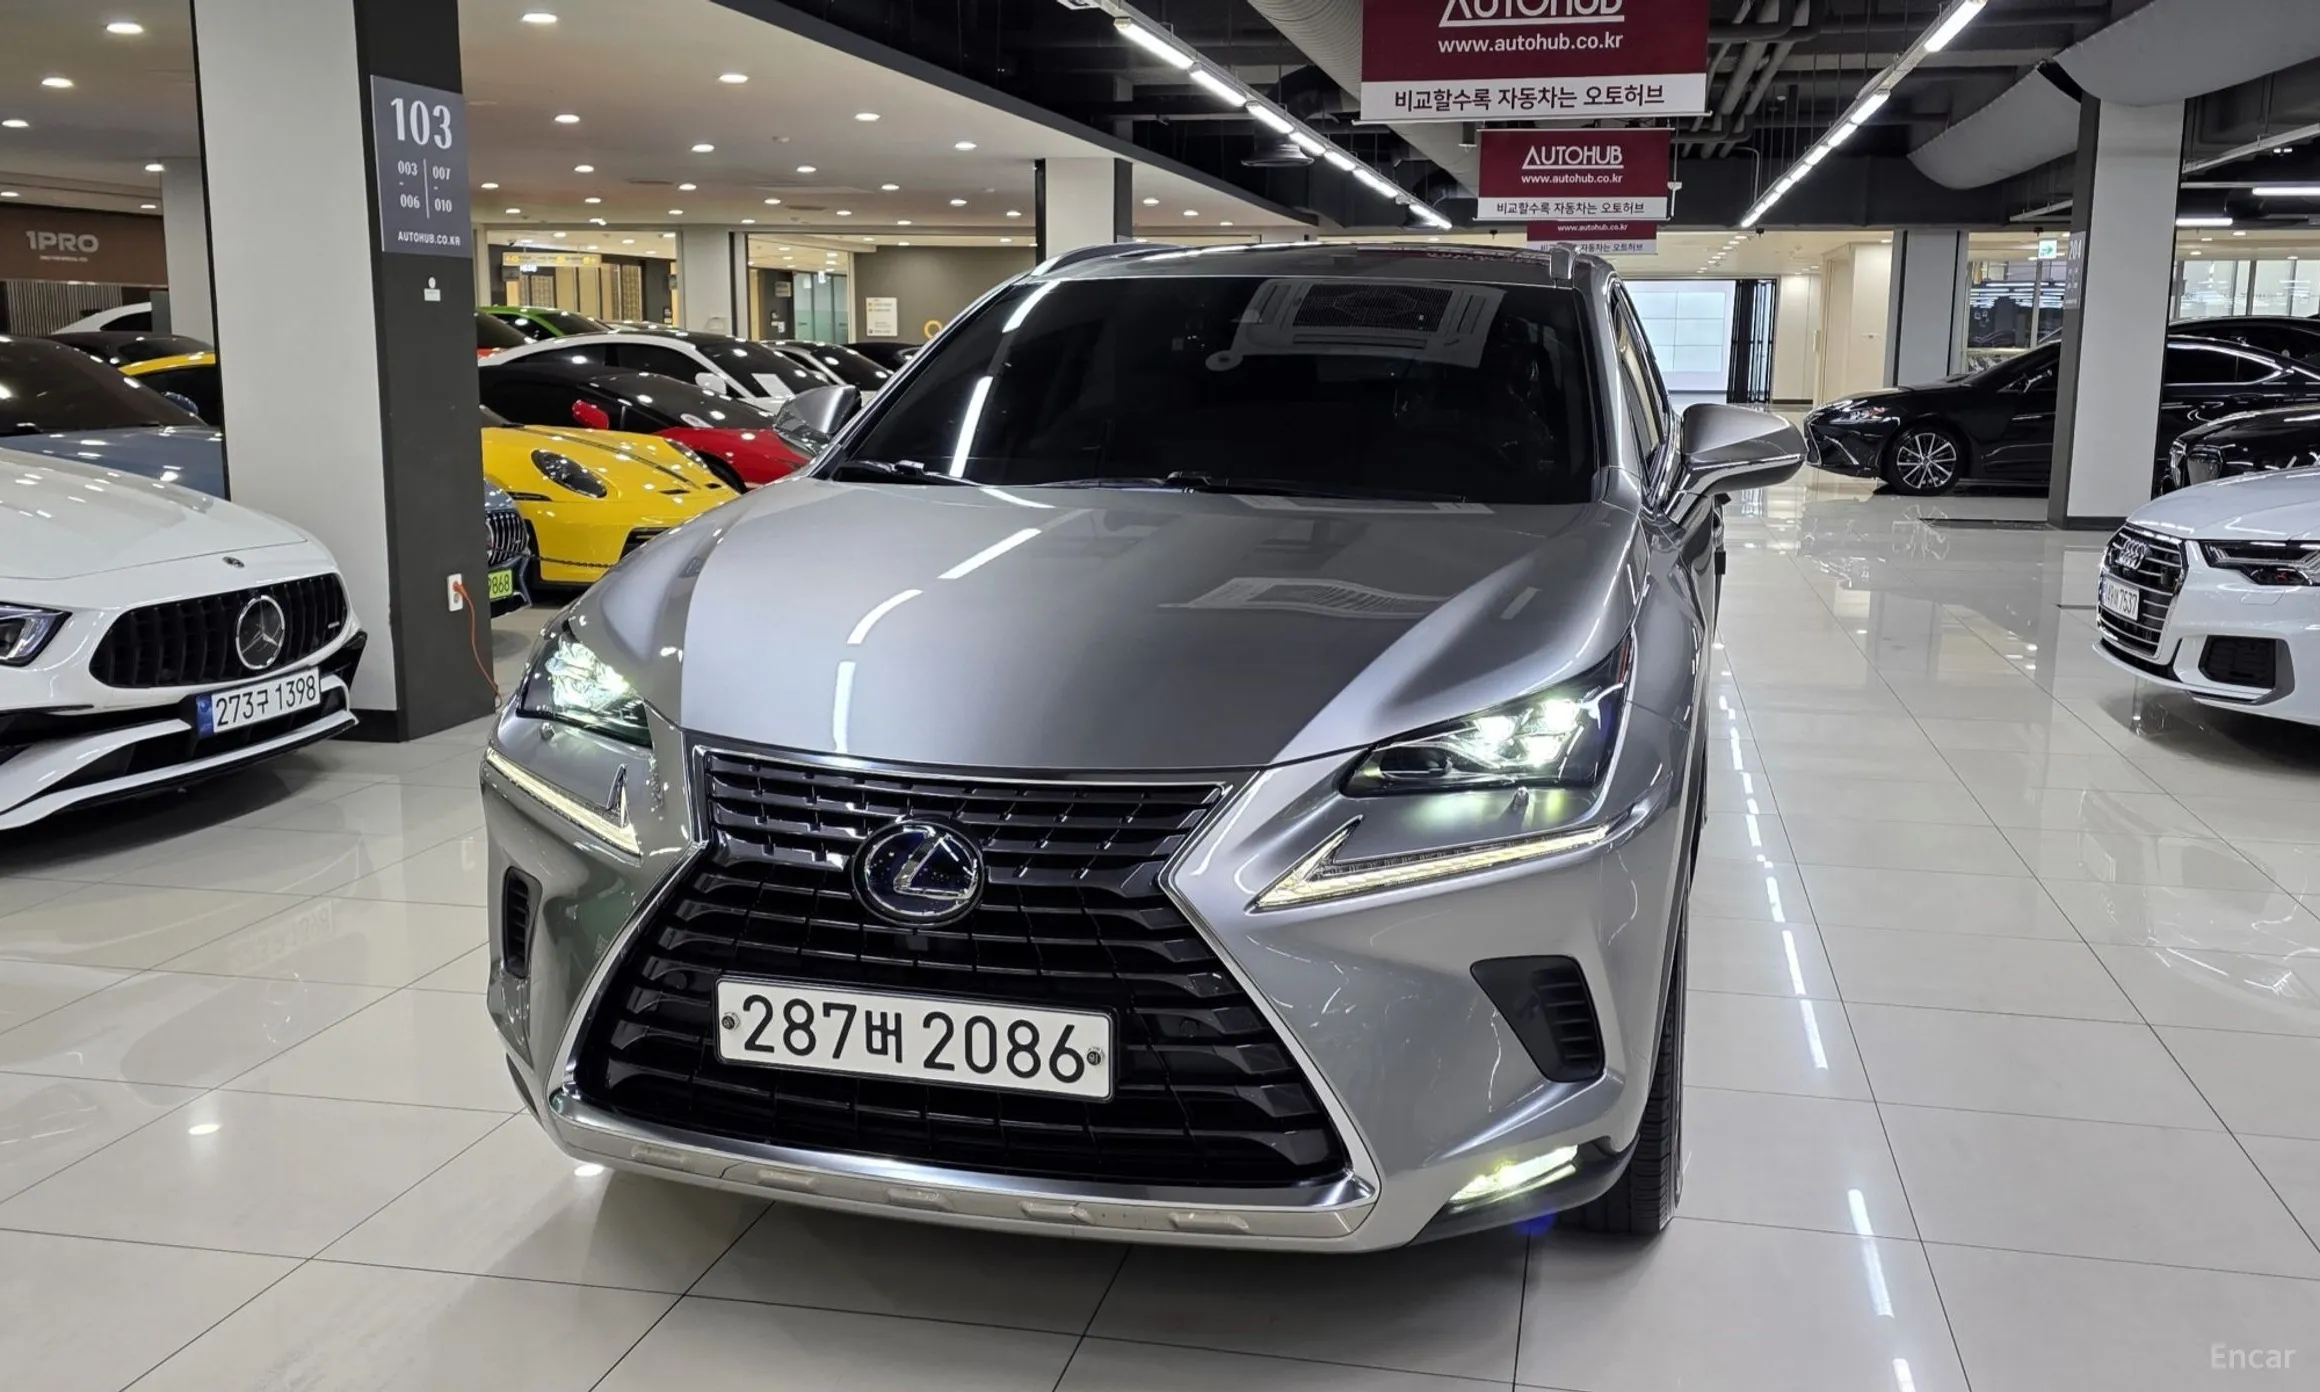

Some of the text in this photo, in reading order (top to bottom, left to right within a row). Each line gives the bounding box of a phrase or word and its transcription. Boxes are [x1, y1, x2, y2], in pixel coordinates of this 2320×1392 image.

[1438, 31, 1624, 53] www.autohub.co.kr
[1394, 83, 1665, 113] 비교할수록 자동차는 오토허브
[390, 97, 453, 150] 103
[1521, 145, 1624, 170] AUTOHUB
[397, 160, 418, 176] 003
[432, 166, 451, 181] 007
[1521, 173, 1624, 184] www.autohub.co.kr
[399, 194, 420, 209] 006
[434, 198, 453, 213] 010
[1496, 202, 1645, 215] 비교할수록 자동차는 오토허브
[1557, 223, 1628, 232] www.autohub.co.kr
[25, 230, 99, 253] 1PRO
[397, 230, 461, 247] AUTOHUB.CO.KR
[215, 674, 317, 728] 273구 1398
[742, 994, 1085, 1084] 287버 2086
